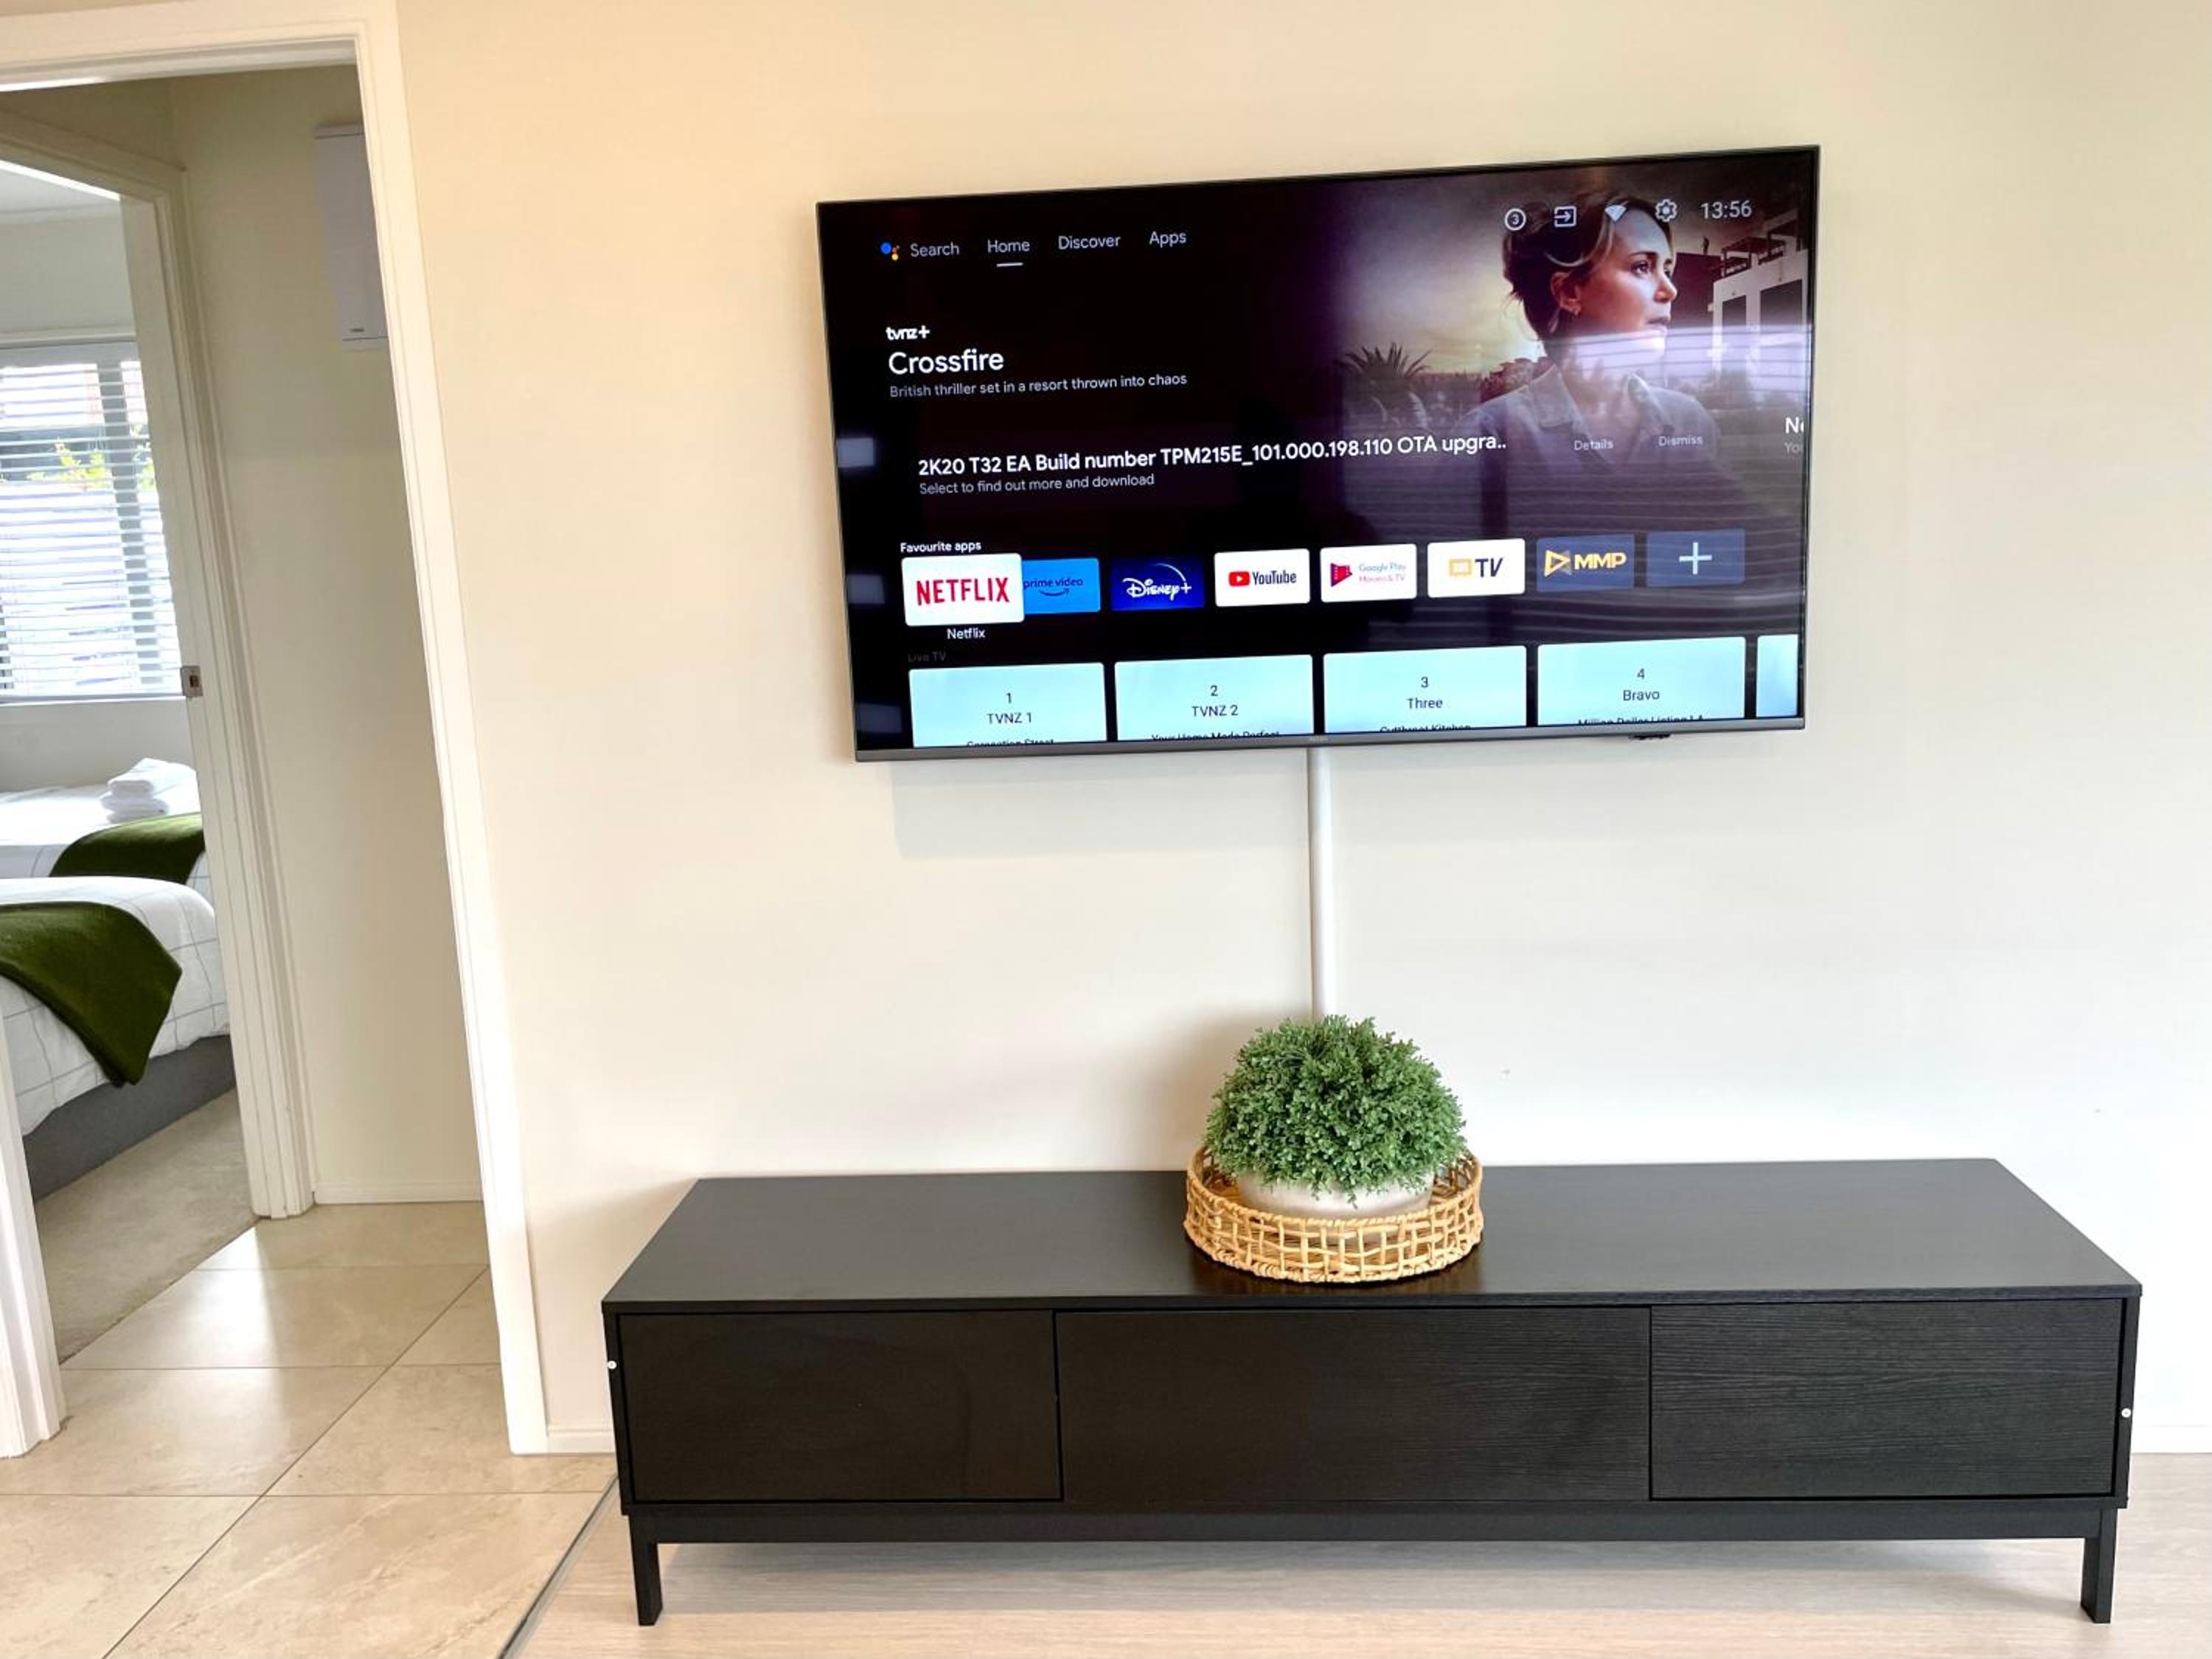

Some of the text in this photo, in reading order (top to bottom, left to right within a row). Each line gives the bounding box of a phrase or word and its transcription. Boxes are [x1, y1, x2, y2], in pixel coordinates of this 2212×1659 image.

[1700, 201, 1752, 220] 13:56
[1057, 234, 1121, 250] Discover
[1149, 231, 1186, 247] Apps
[910, 241, 960, 257] Search
[987, 239, 1030, 254] Home
[886, 325, 931, 340] tvnz+
[888, 348, 1004, 375] Crossfire
[889, 372, 1188, 398] British thriller set in a resort thrown into chaos
[1574, 438, 1613, 451] Details
[1658, 434, 1704, 447] Dismiss
[918, 459, 965, 476] 2K20
[969, 456, 1002, 473] T32
[1006, 455, 1032, 473] EA
[1036, 453, 1081, 470] Build
[1085, 451, 1156, 469] number
[1160, 438, 1393, 466] TPM215E_101.000.198.110
[1397, 436, 1438, 453] OTA
[919, 473, 1155, 495] Select to find out more and download
[900, 540, 982, 553] Favourite apps
[1358, 561, 1407, 574] Google Play
[1475, 557, 1504, 578] TV
[1574, 550, 1627, 571] MMP
[1023, 577, 1084, 591] prime video
[1252, 570, 1297, 585] YouTube
[1395, 573, 1406, 582] TV
[916, 577, 1010, 607] NETFLIX
[947, 627, 986, 640] Netflix
[908, 651, 947, 662] Live TV
[1637, 668, 1646, 680] 4
[1421, 677, 1429, 688] 3
[1006, 692, 1012, 704] 1
[1209, 685, 1218, 697] 2
[1622, 688, 1660, 702] Bravo
[1406, 695, 1443, 710] Three
[986, 711, 1032, 725] TVNZ 1
[1192, 704, 1239, 718] TVNZ 2
